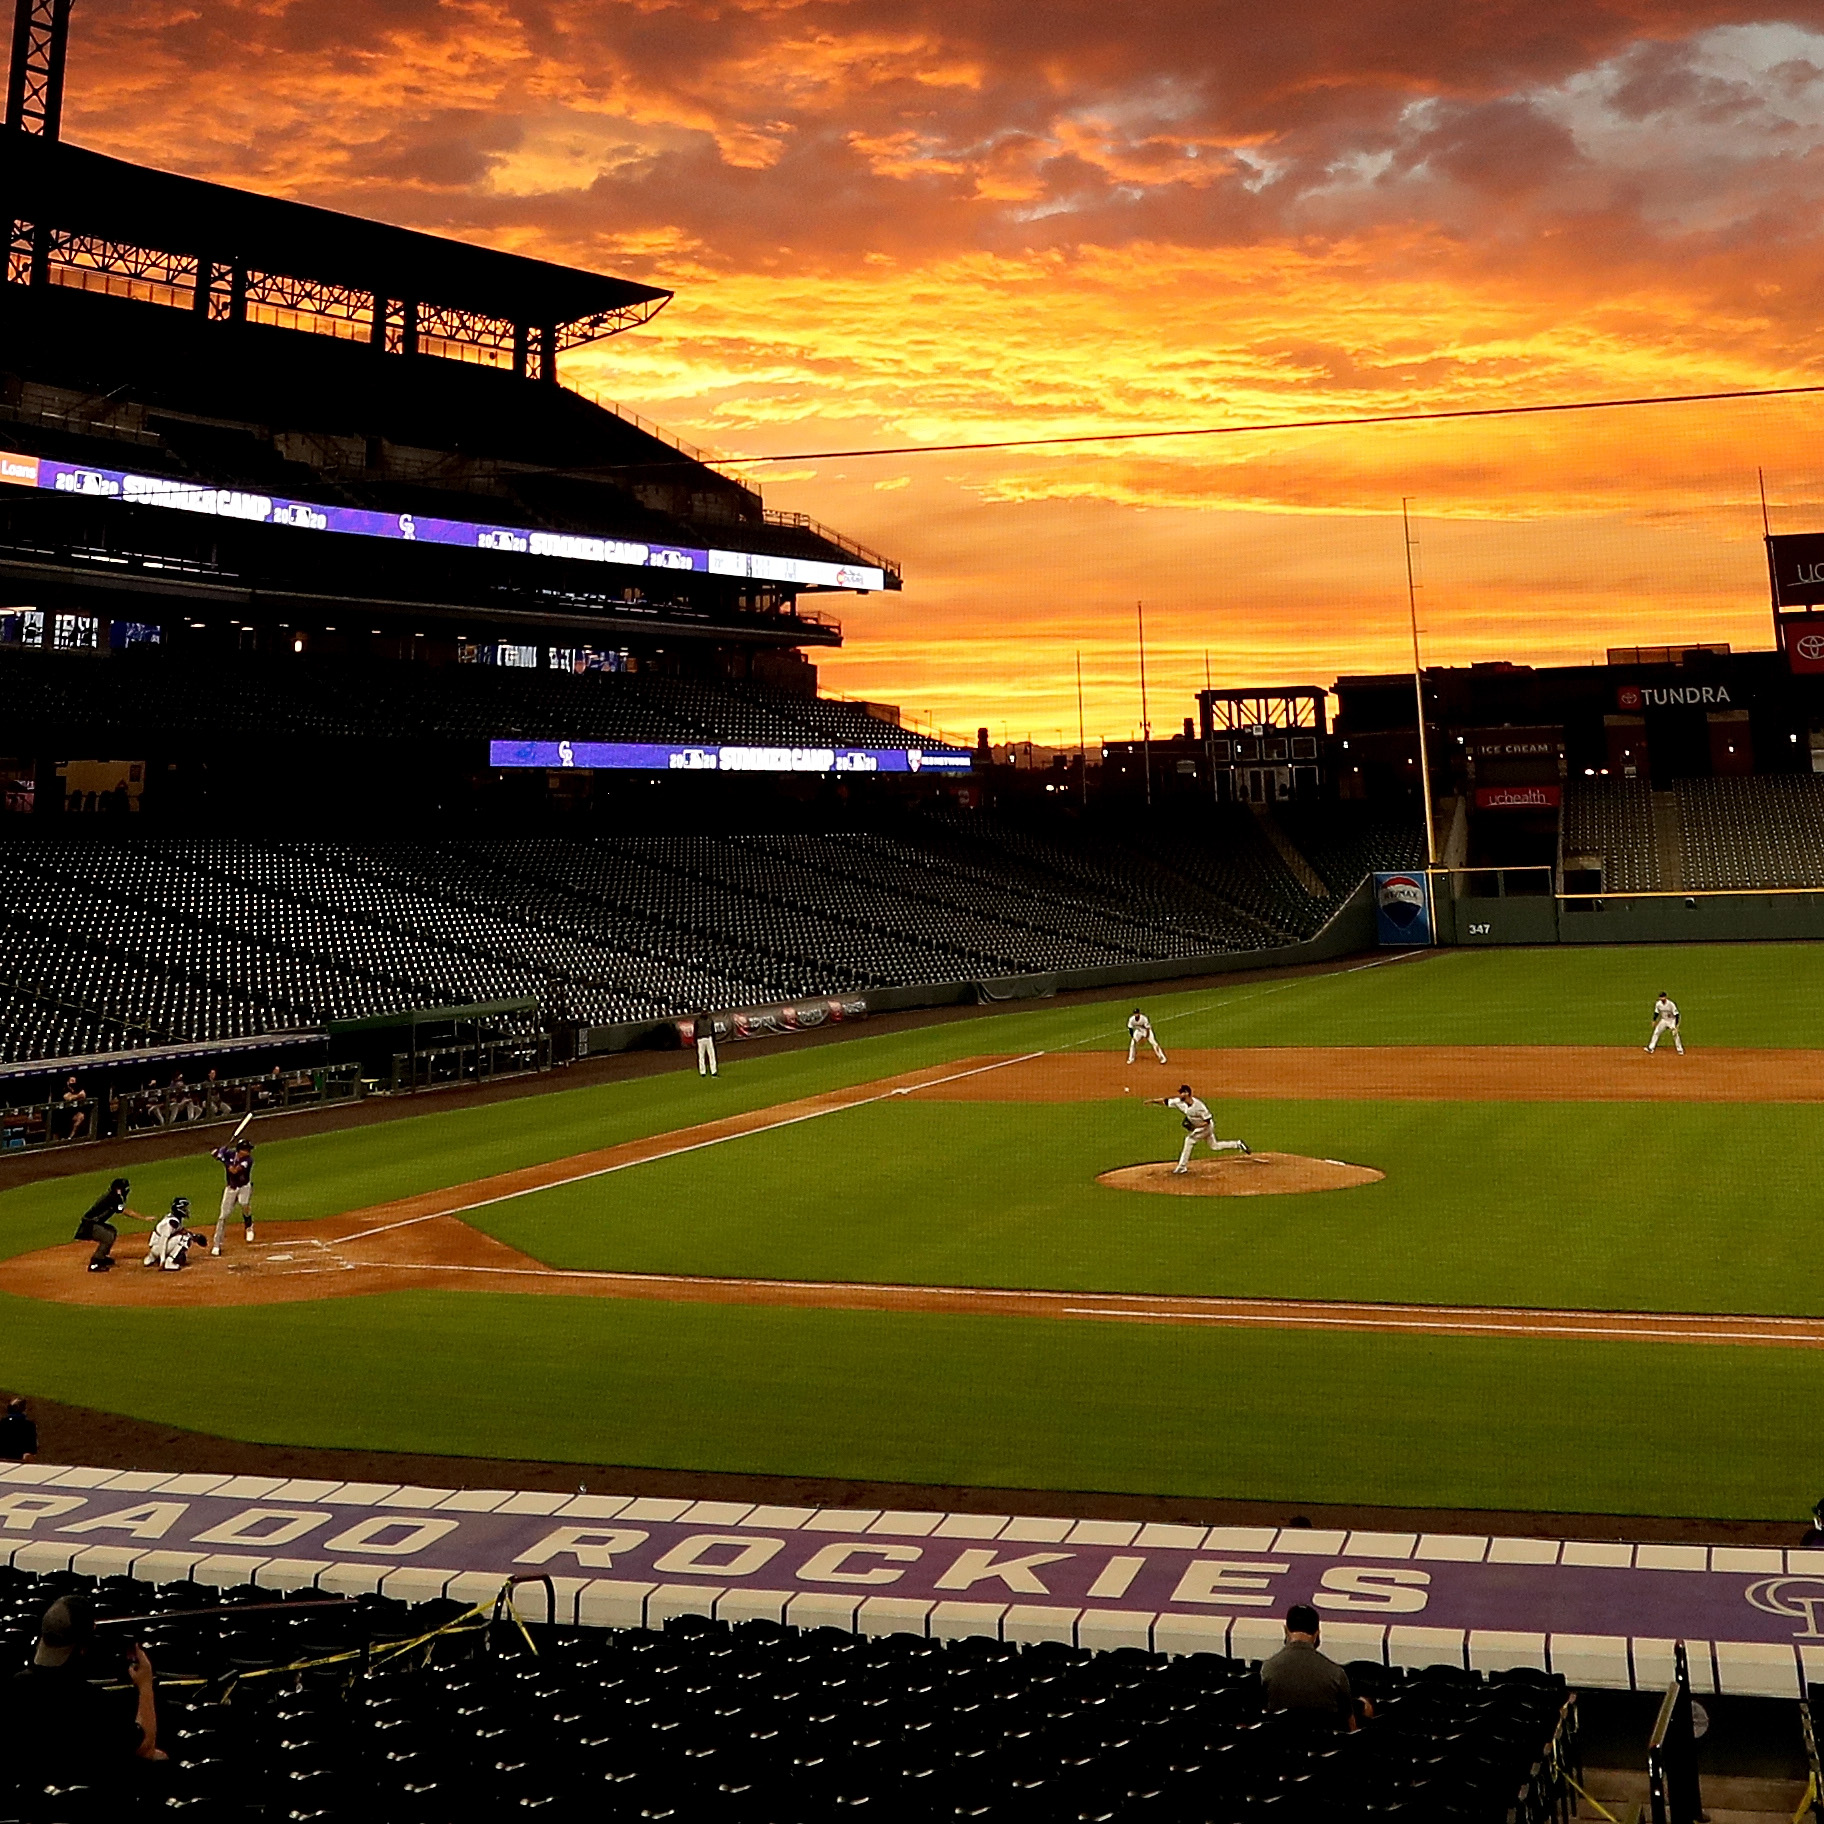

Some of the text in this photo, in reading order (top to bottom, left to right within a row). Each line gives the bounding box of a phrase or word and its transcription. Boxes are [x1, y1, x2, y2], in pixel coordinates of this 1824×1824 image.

[2, 460, 36, 479] Loans
[1640, 686, 1731, 707] TUNDRA
[1481, 745, 1548, 754] ICE CREAM
[1489, 789, 1546, 805] uchealth
[1469, 922, 1491, 935] 347
[513, 1524, 1433, 1615] ROCKIES
